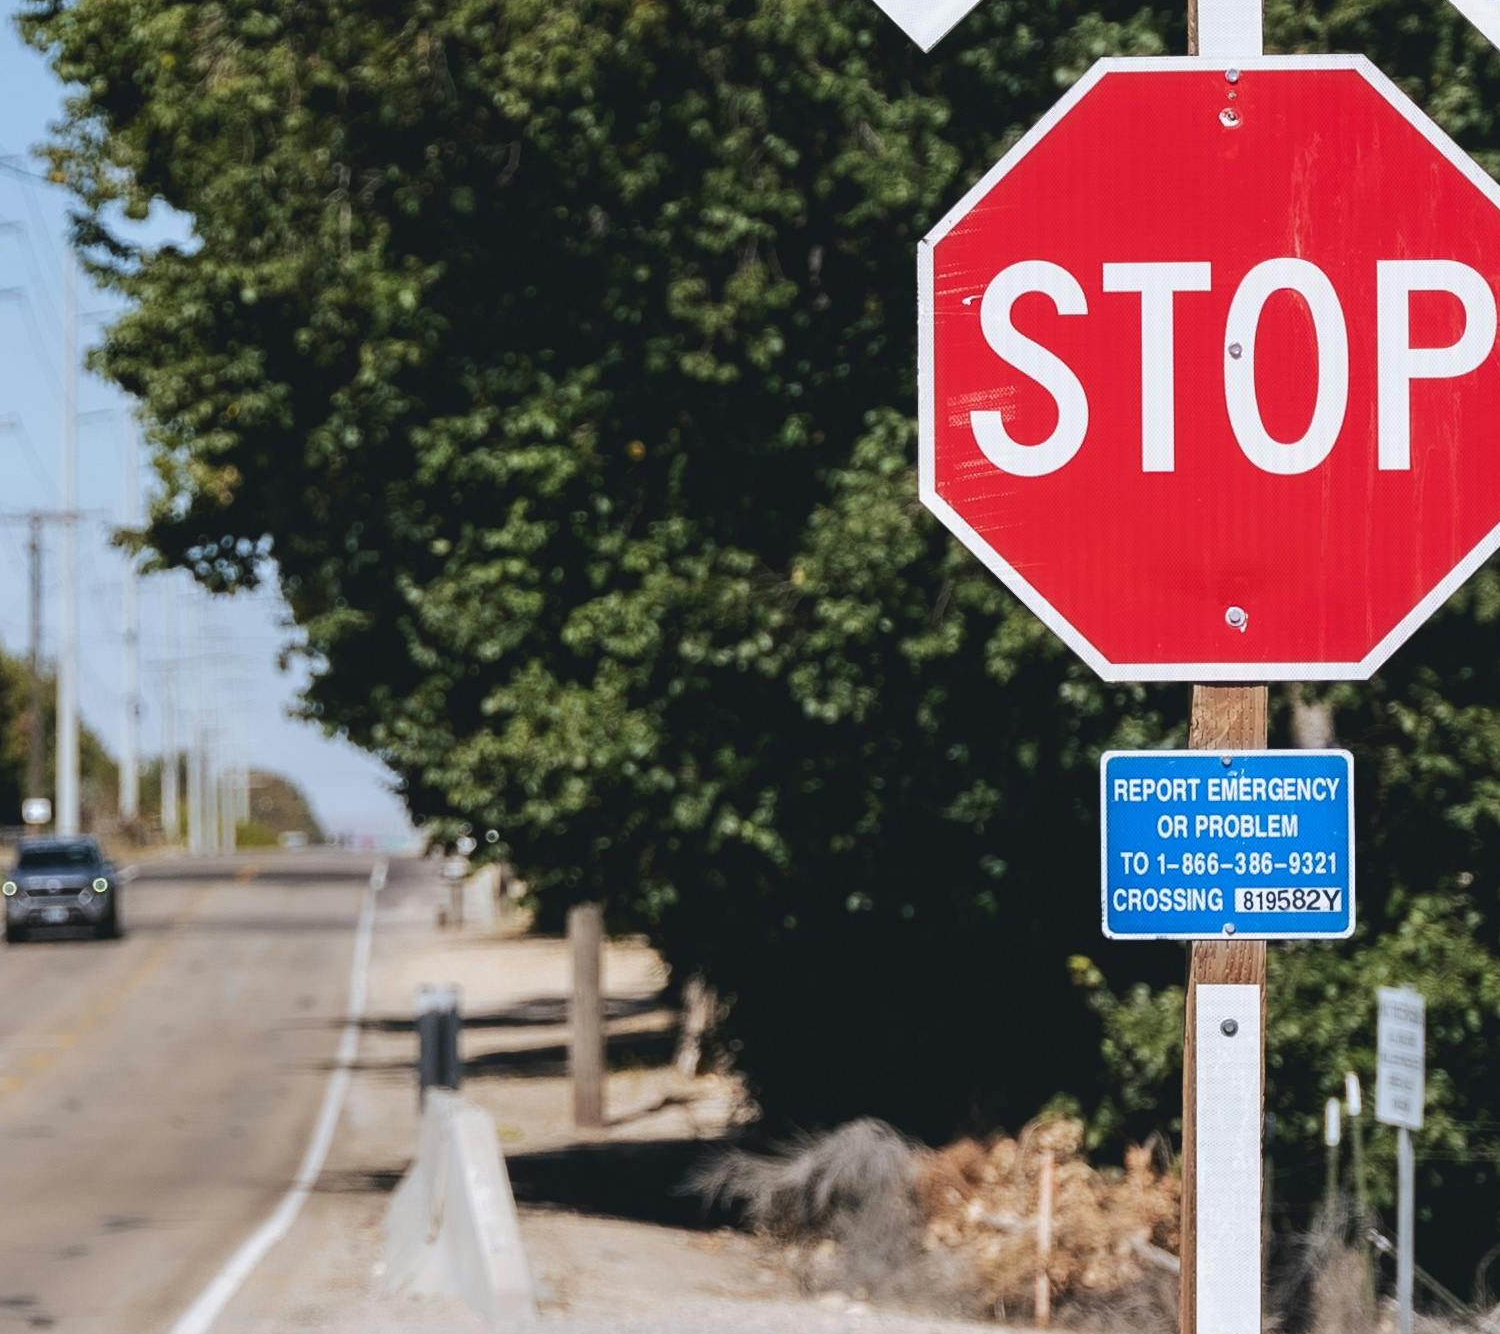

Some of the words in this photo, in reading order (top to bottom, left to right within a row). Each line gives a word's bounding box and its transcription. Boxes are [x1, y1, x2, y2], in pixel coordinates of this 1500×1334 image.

[969, 257, 1499, 477] STOP
[1113, 778, 1200, 802] REPORT
[1207, 778, 1340, 802] EMERGENCY
[1157, 814, 1188, 839] OR
[1195, 814, 1299, 838] PROBLEM
[1120, 851, 1149, 875] TO
[1157, 851, 1337, 875] 1-866-386-9321
[1113, 887, 1224, 912] CROSSING
[1243, 889, 1341, 911] 819582Y
